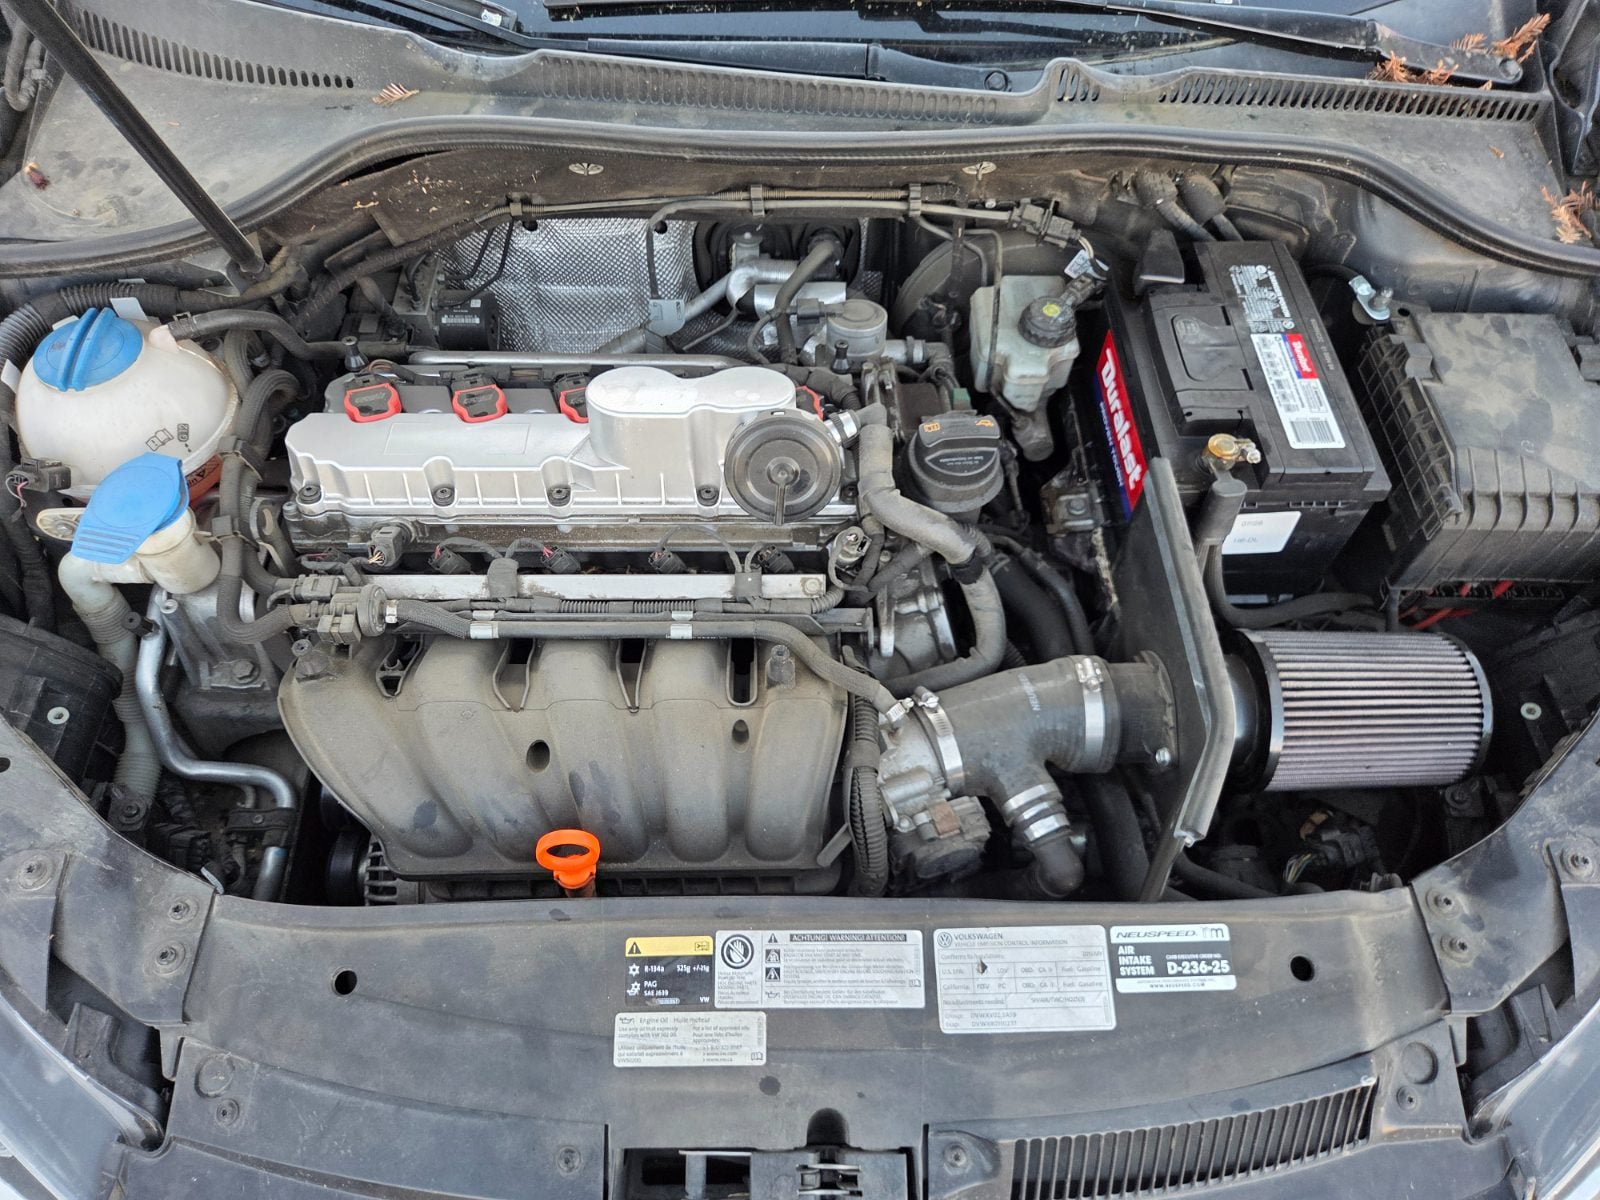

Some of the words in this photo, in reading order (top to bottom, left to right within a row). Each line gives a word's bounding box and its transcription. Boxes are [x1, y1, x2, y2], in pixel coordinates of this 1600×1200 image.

[1101, 347, 1142, 490] Duralast
[1118, 945, 1135, 955] AIR
[1118, 956, 1152, 965] INTAKE
[644, 964, 665, 972] R-134a
[676, 964, 690, 973] 525g
[1120, 966, 1155, 976] SYSTEM
[1166, 960, 1231, 975] D-236-25
